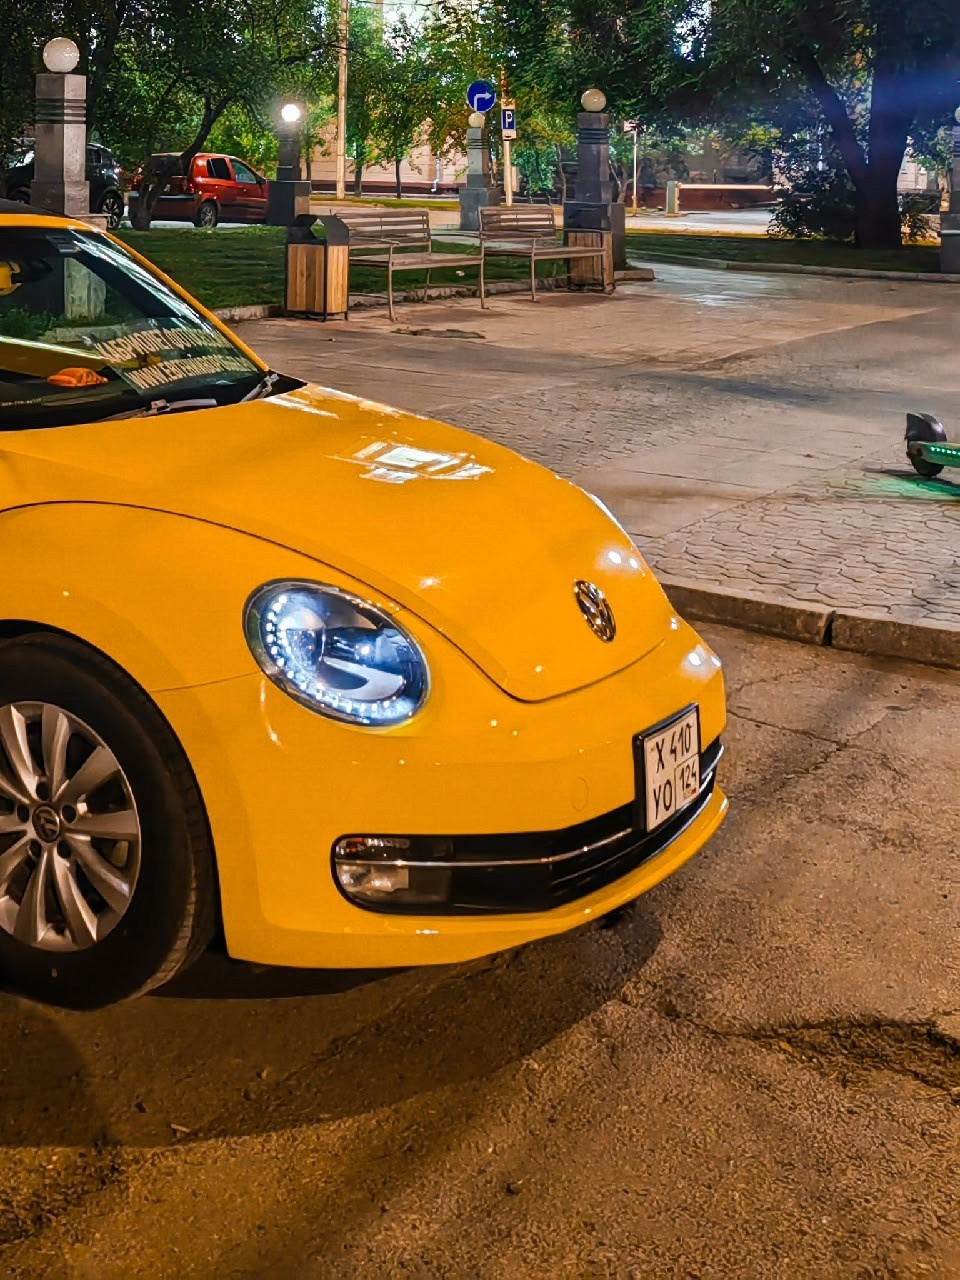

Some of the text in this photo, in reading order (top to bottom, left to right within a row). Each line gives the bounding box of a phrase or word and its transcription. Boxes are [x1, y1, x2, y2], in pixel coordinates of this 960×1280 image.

[505, 110, 513, 129] P
[669, 722, 693, 762] 410
[679, 761, 697, 792] 124
